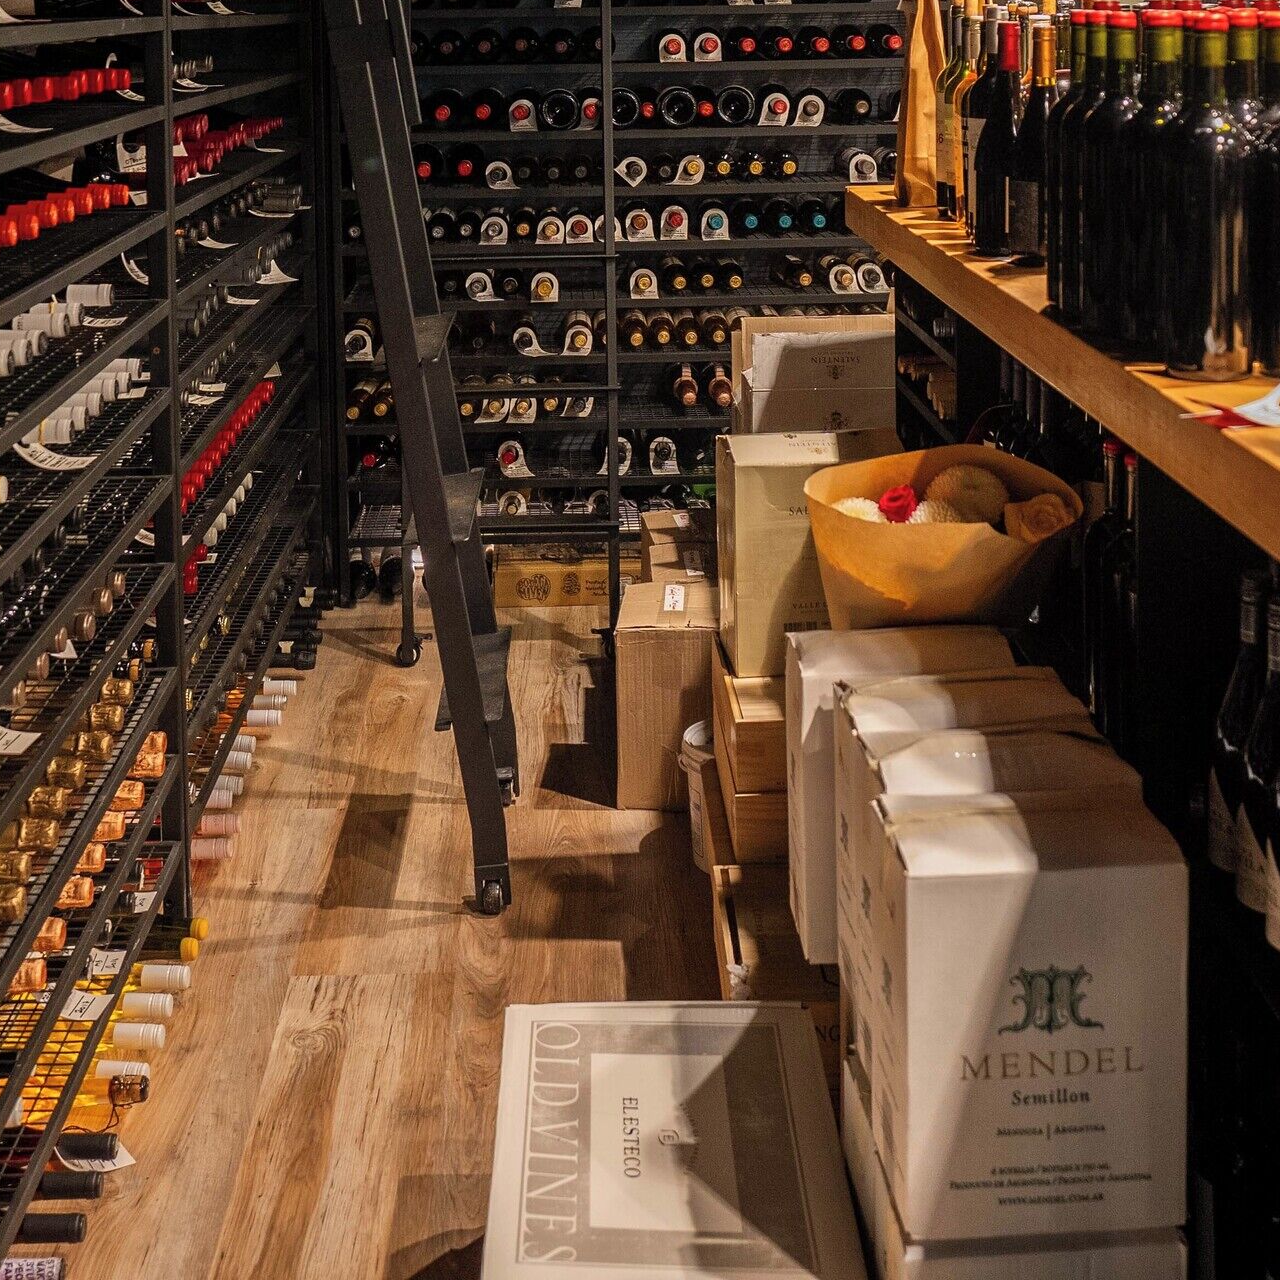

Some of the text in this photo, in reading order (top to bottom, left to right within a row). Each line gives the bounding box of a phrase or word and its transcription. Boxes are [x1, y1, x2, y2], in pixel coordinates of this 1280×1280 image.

[959, 1046, 1145, 1081] MENDEL
[1011, 1087, 1090, 1106] Semillon
[522, 1022, 581, 1263] OLD VINES
[622, 1097, 641, 1178] EL ESTECO
